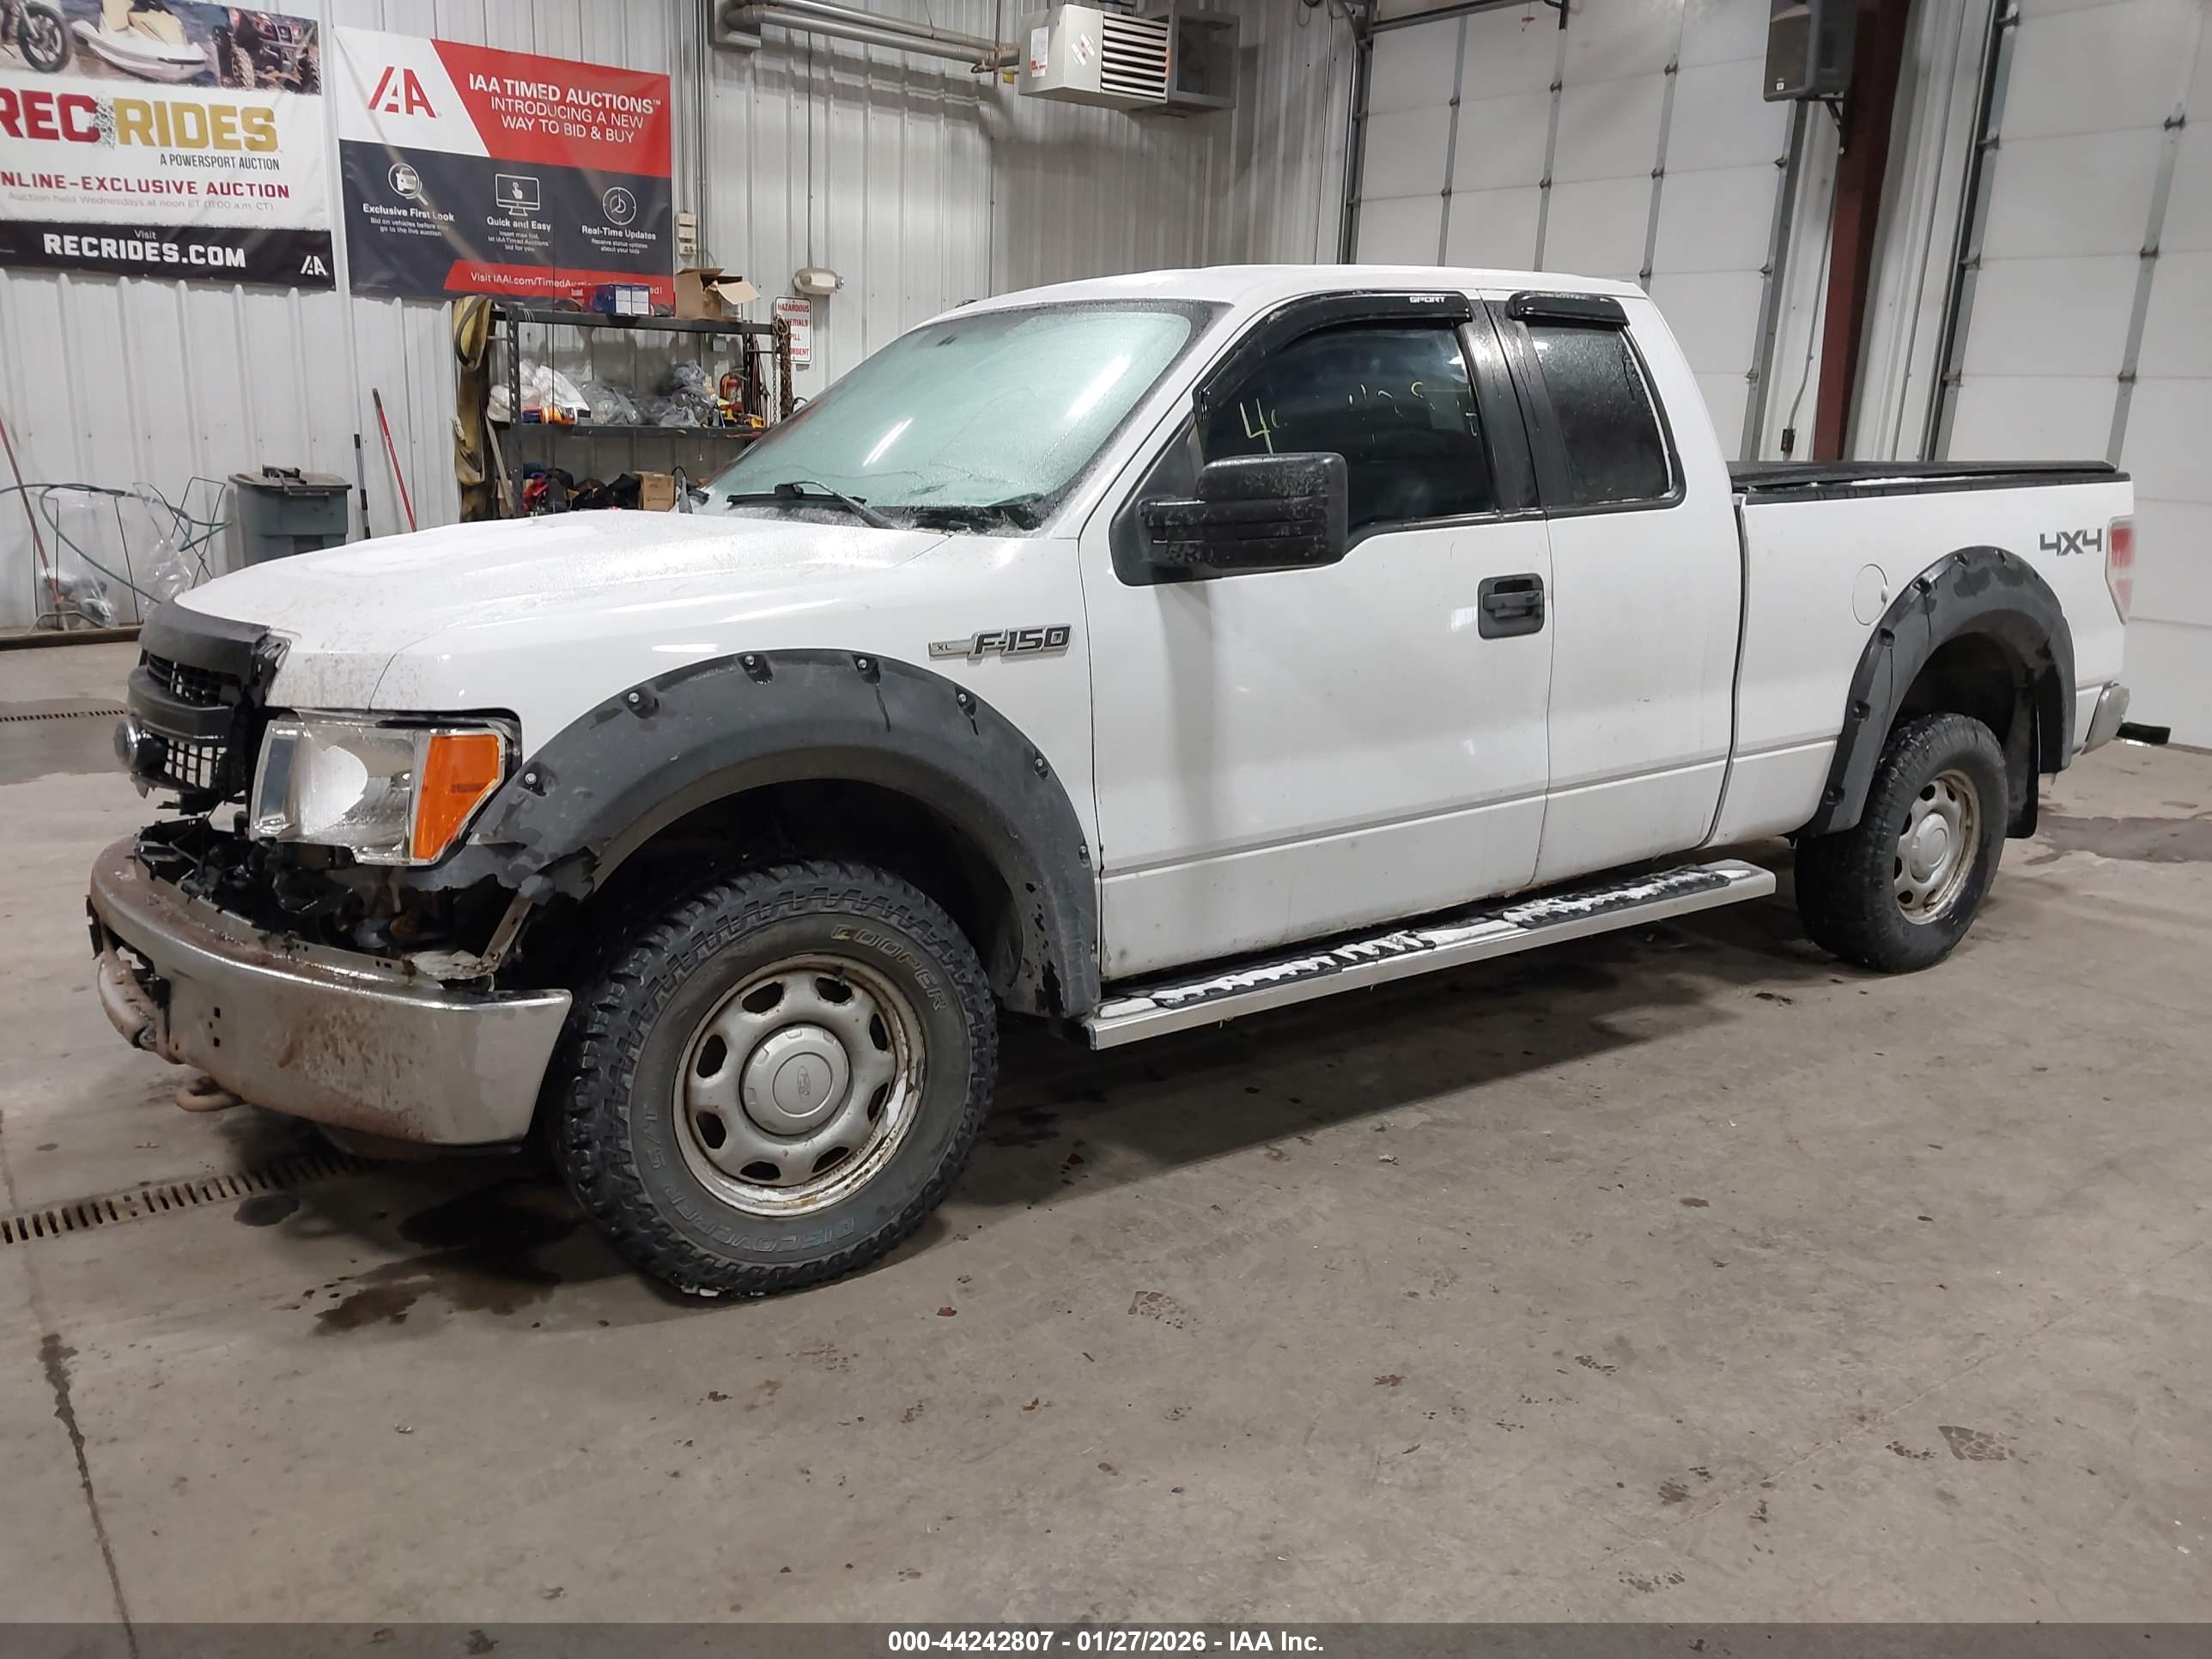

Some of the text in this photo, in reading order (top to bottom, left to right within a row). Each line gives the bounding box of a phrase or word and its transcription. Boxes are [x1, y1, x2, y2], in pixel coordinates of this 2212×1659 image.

[469, 73, 501, 94] IAA
[503, 78, 561, 101] TIMED
[491, 95, 644, 129] INTRODUCING A NEW
[112, 97, 278, 153] RIDES
[501, 114, 635, 143] WAY TO BID & BUY
[160, 154, 280, 171] A POWERSPORT AUCTION
[0, 171, 289, 198] NLINE-EXCLUSIVE AUCTION
[159, 199, 185, 208] noon
[362, 203, 454, 222] Exclusive First Look
[487, 216, 551, 232] Quick and Easy
[581, 225, 657, 240] Real-Time Updates
[134, 229, 156, 240] Visit
[43, 233, 246, 268] RECRIDES.COM
[471, 272, 491, 283] Visit
[778, 303, 810, 313] HAZARDOUS
[973, 625, 1072, 657] F-150
